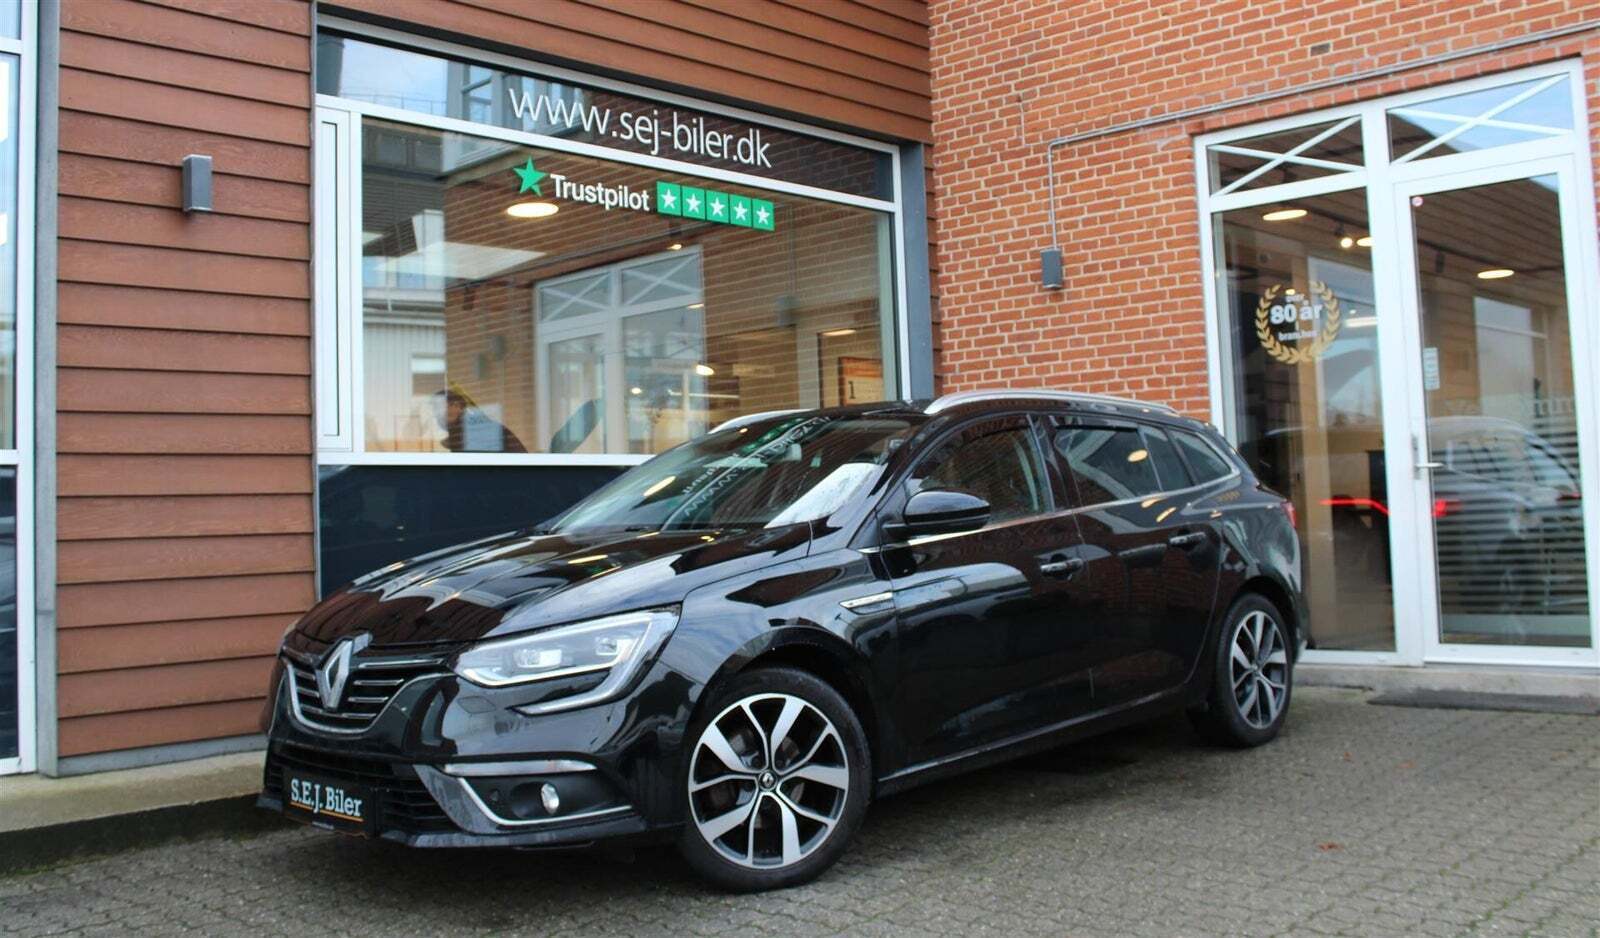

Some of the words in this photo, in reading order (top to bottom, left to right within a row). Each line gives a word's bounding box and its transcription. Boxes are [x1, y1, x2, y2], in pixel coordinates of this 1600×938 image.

[509, 88, 772, 168] www.sej-biler.dk
[550, 174, 650, 211] Trustpilot
[1270, 303, 1297, 324] 80
[1299, 300, 1323, 320] år
[291, 778, 323, 814] S.E.J.
[325, 786, 362, 817] Biler
